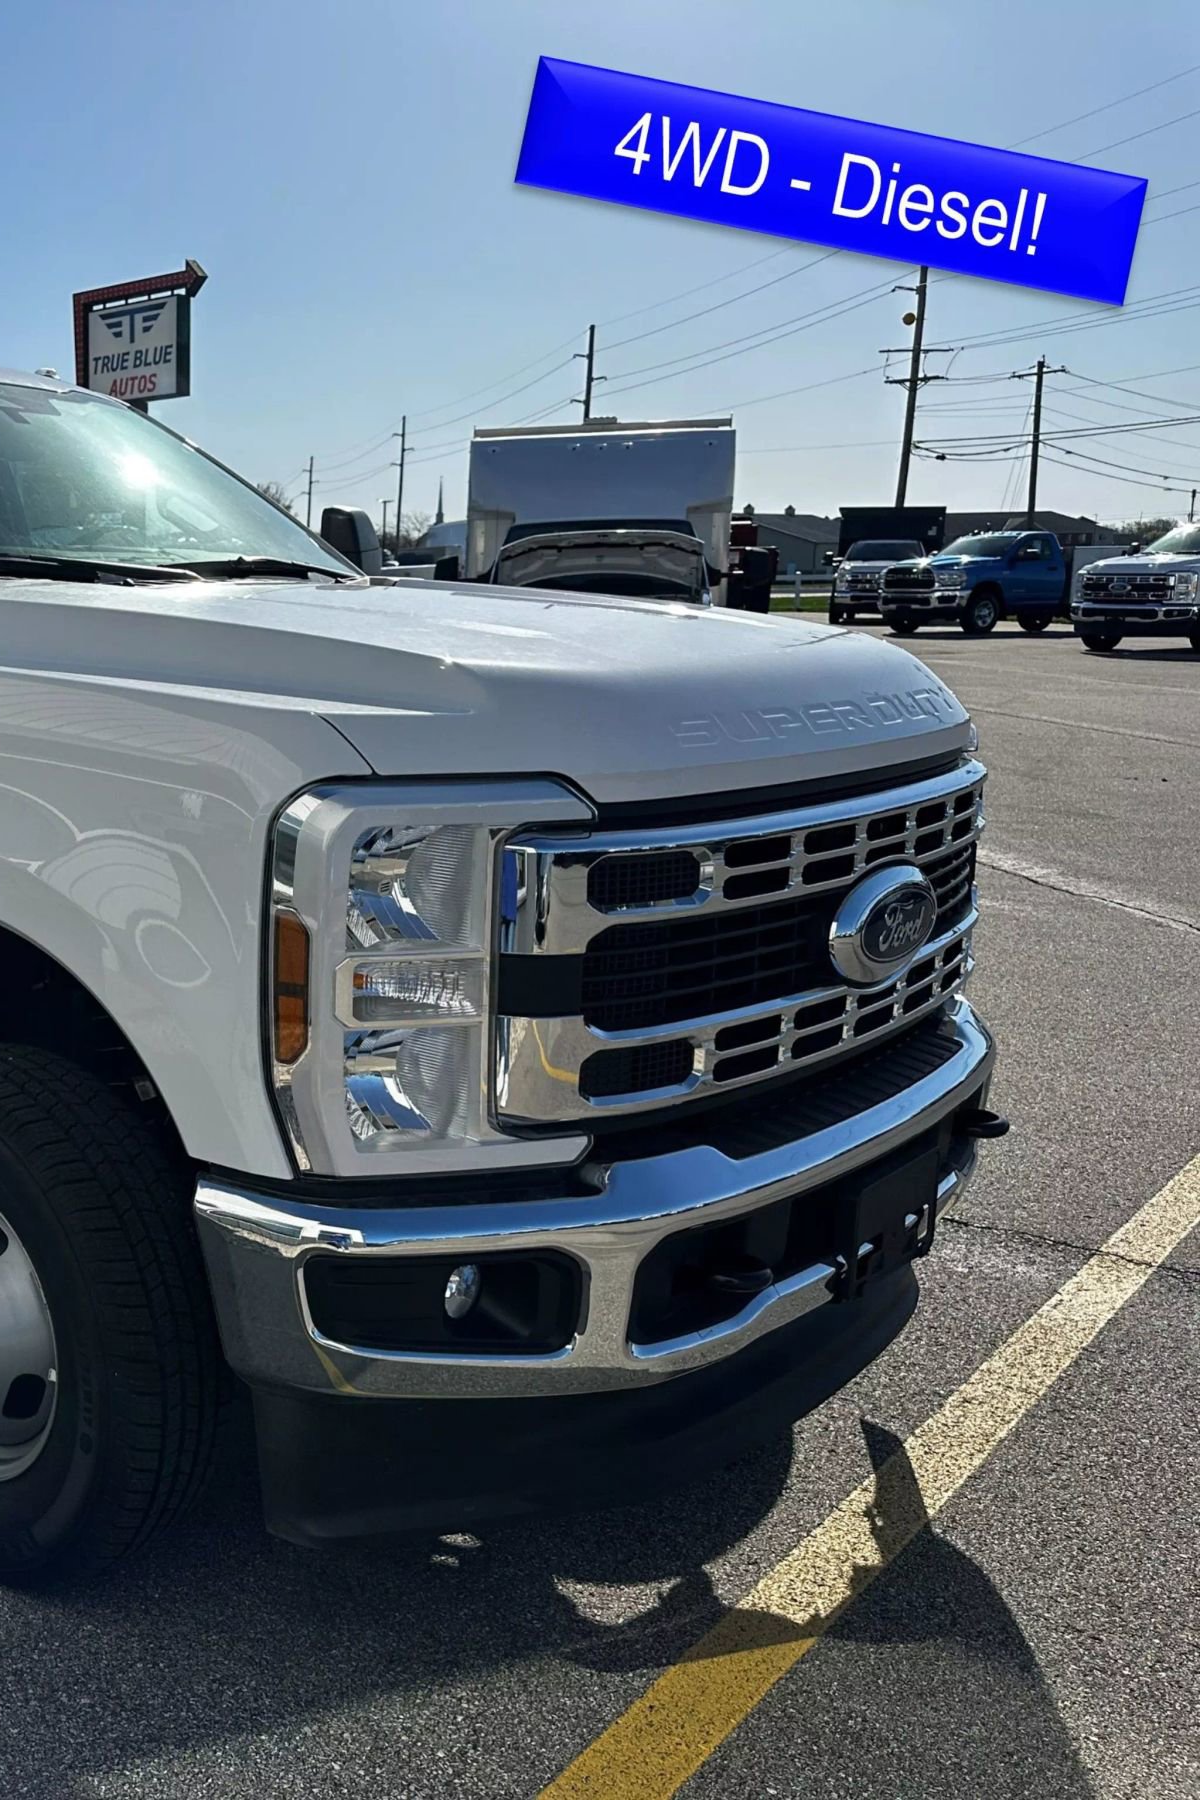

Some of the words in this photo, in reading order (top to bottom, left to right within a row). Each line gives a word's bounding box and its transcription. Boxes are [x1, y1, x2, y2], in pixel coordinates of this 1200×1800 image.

[92, 351, 130, 375] TRUE
[132, 344, 174, 369] BLUE
[109, 373, 157, 397] AUTOS
[878, 900, 926, 952] Ford
